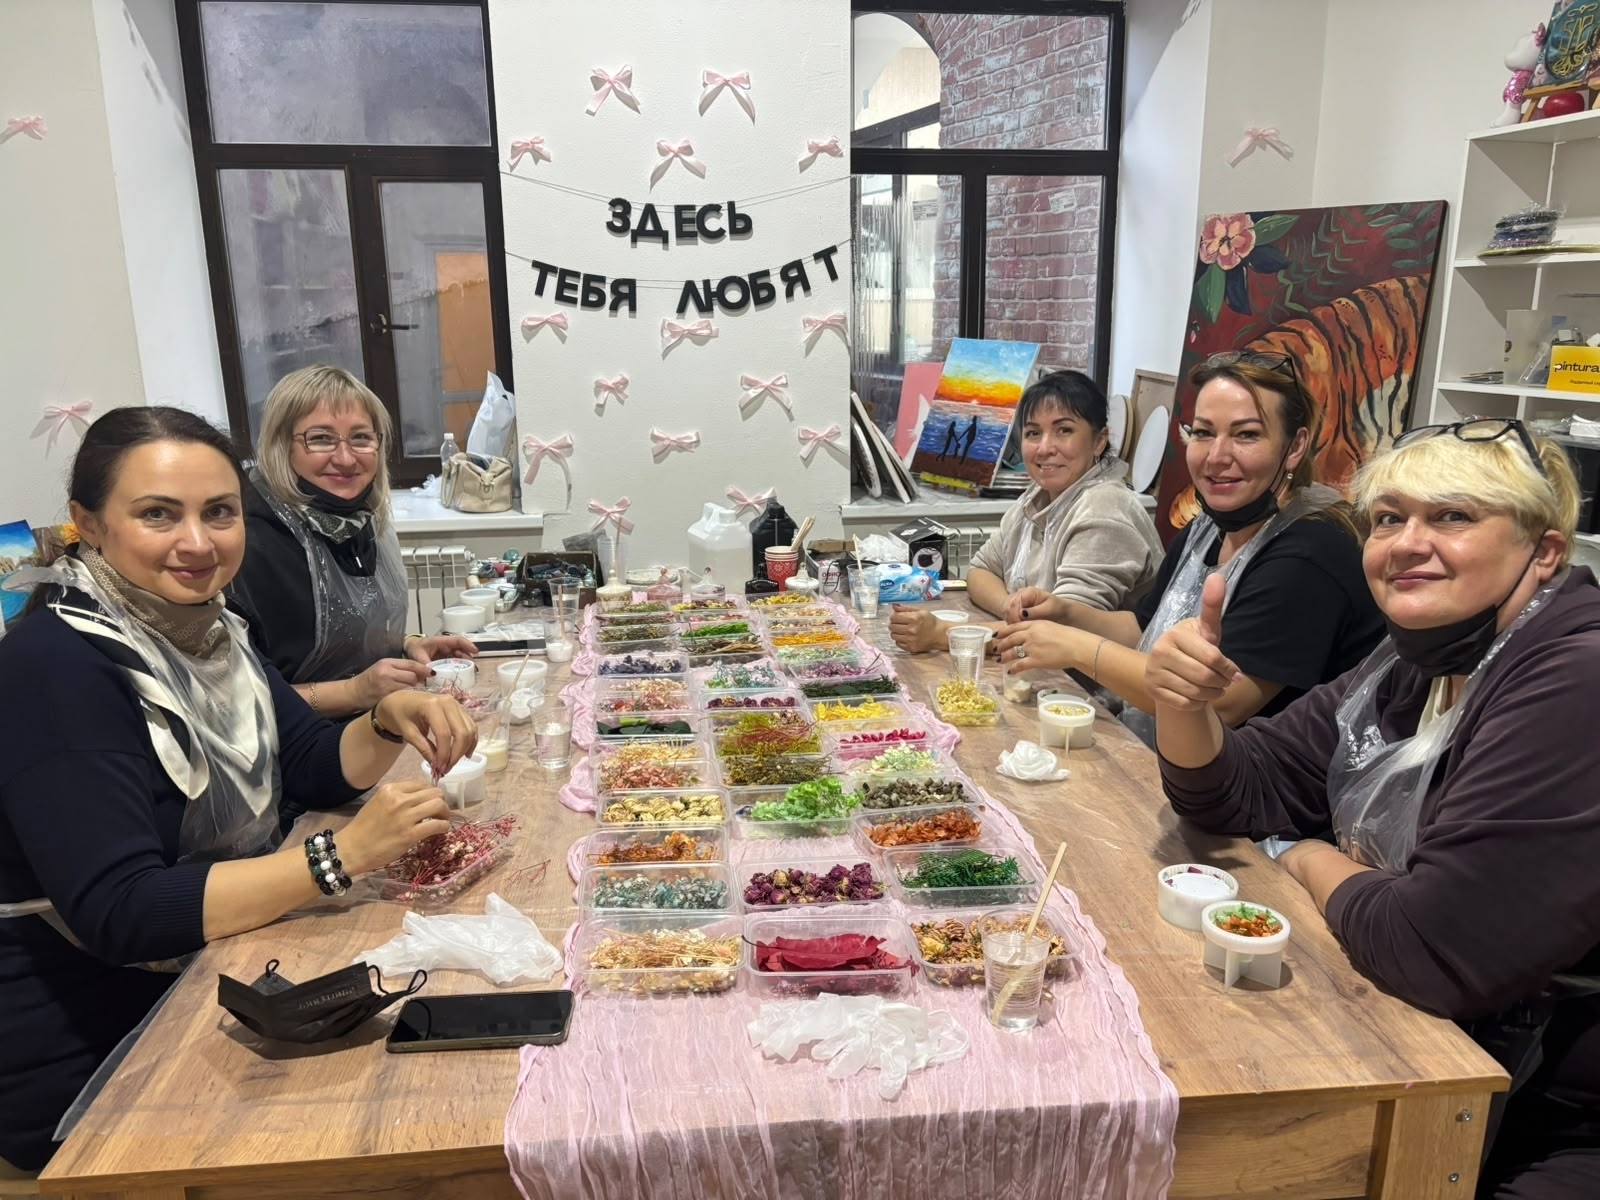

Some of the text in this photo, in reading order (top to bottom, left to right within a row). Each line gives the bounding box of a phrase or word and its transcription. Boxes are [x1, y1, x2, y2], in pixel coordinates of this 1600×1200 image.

[606, 198, 753, 246] ЗДЕСЬ
[531, 245, 839, 315] ТЕБЯ ЛЮБЯТ
[1554, 361, 1600, 372] pintura
